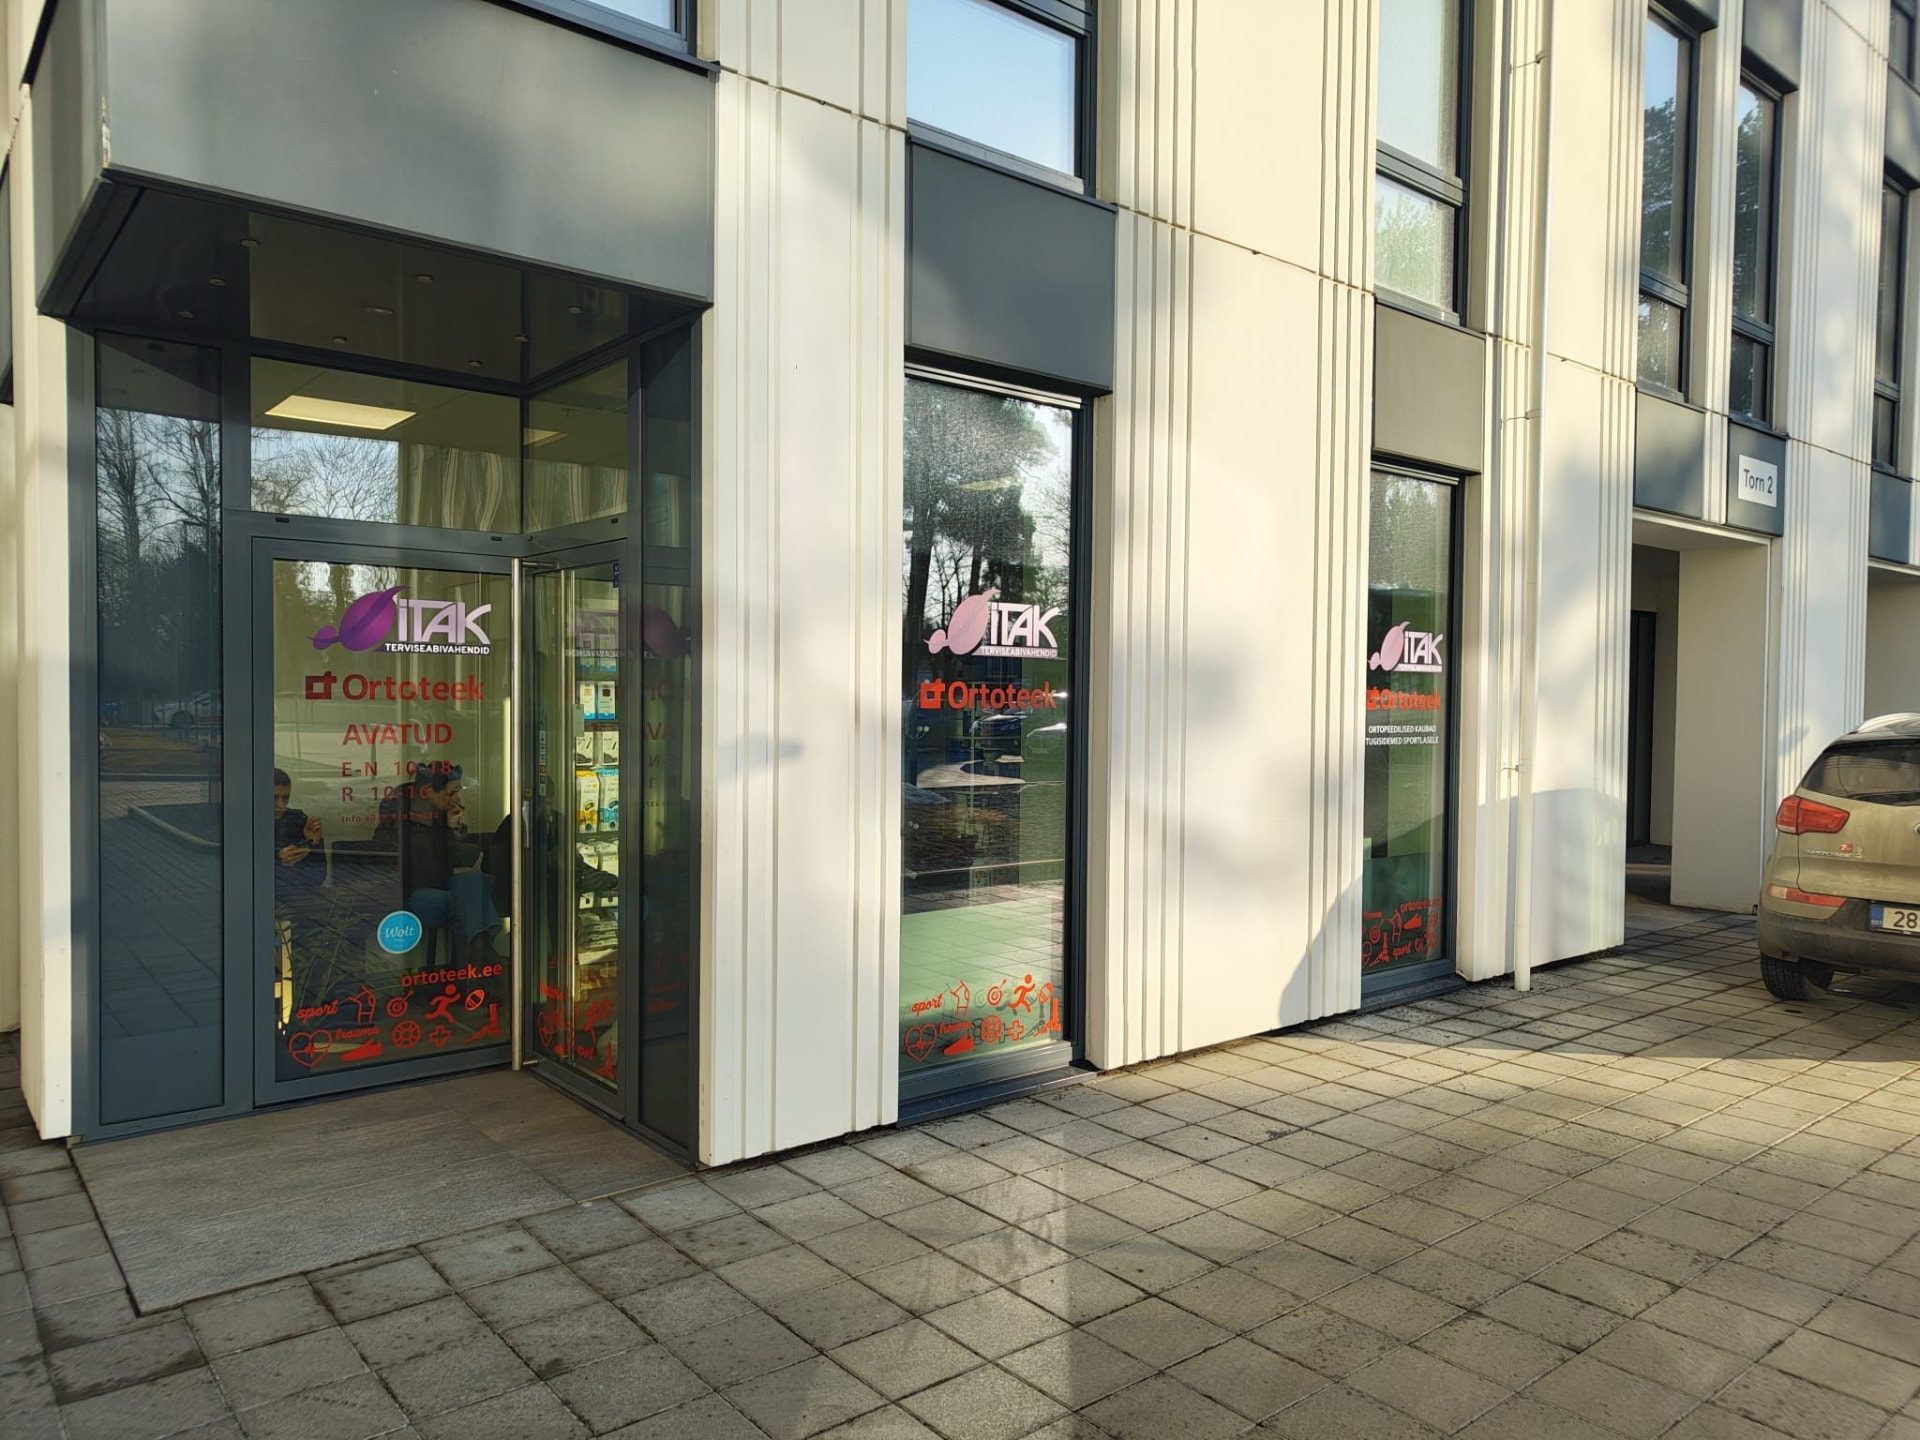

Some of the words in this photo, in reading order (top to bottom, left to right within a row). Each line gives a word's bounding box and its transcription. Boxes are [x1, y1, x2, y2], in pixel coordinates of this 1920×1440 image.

[1743, 468, 1765, 492] Torn
[1767, 475, 1773, 494] 2
[385, 642, 490, 655] TERVISEABIVAHENDID
[342, 673, 485, 702] Ortoteek
[948, 680, 1057, 710] Ortoteek
[342, 723, 452, 746] AVATUD
[342, 786, 354, 802] R
[385, 925, 415, 938] Wolt
[401, 963, 503, 988] ortoteek.ee
[296, 999, 339, 1025] sport
[911, 992, 943, 1017] sport
